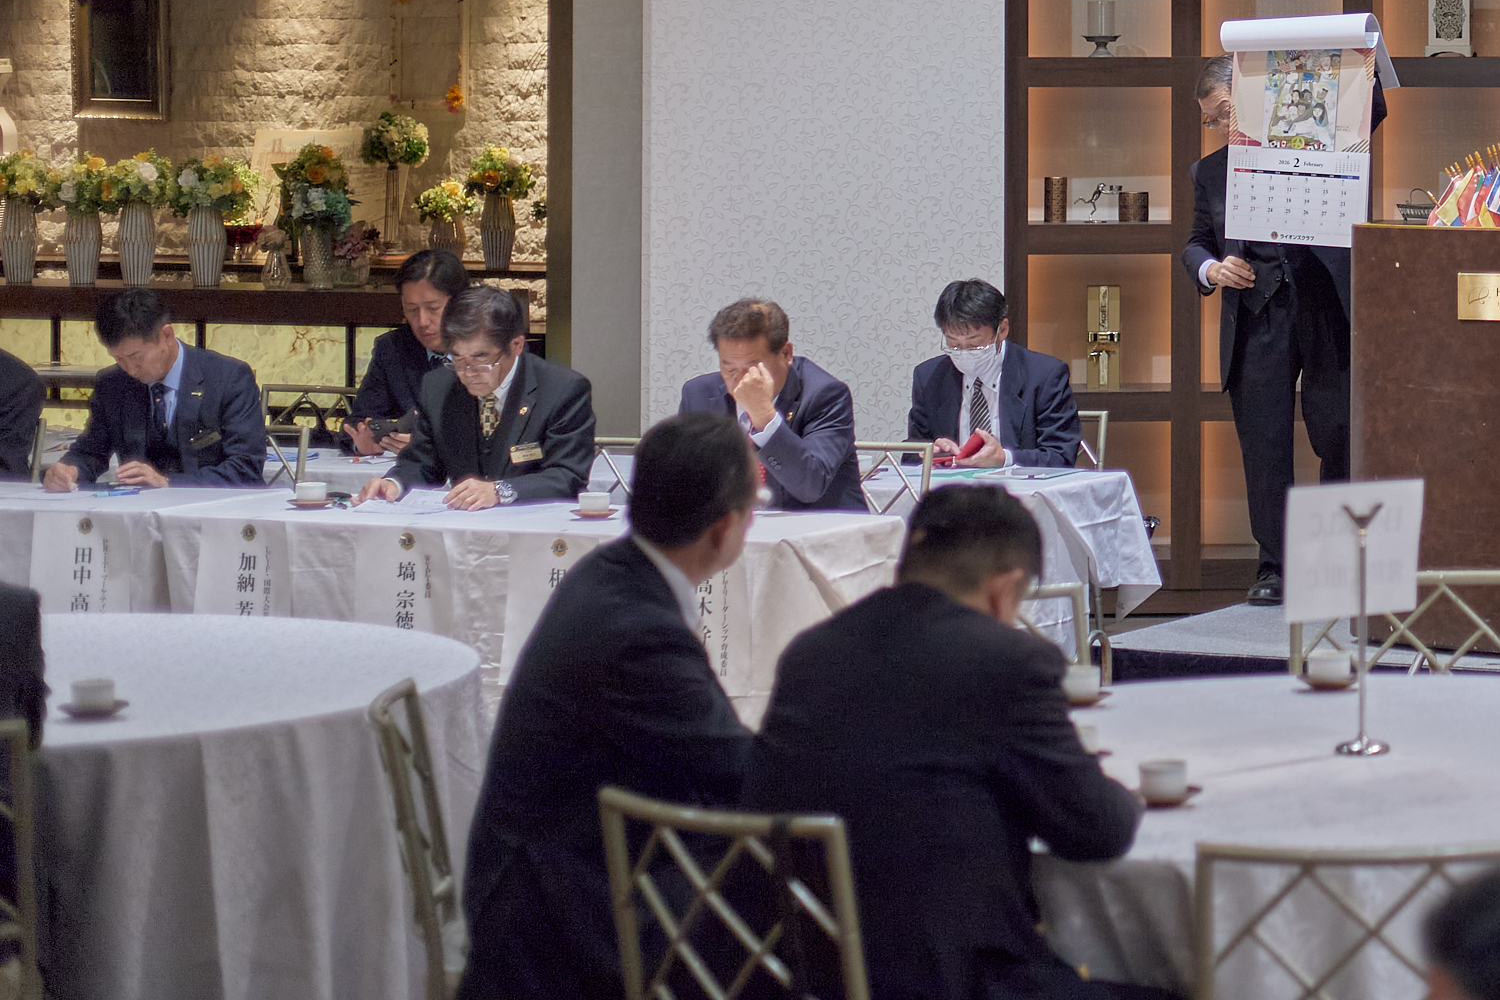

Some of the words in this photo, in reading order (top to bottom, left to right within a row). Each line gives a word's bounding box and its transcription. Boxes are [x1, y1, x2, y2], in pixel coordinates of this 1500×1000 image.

[1293, 157, 1300, 168] 2
[73, 547, 93, 585] 田中
[236, 552, 257, 593] 加納
